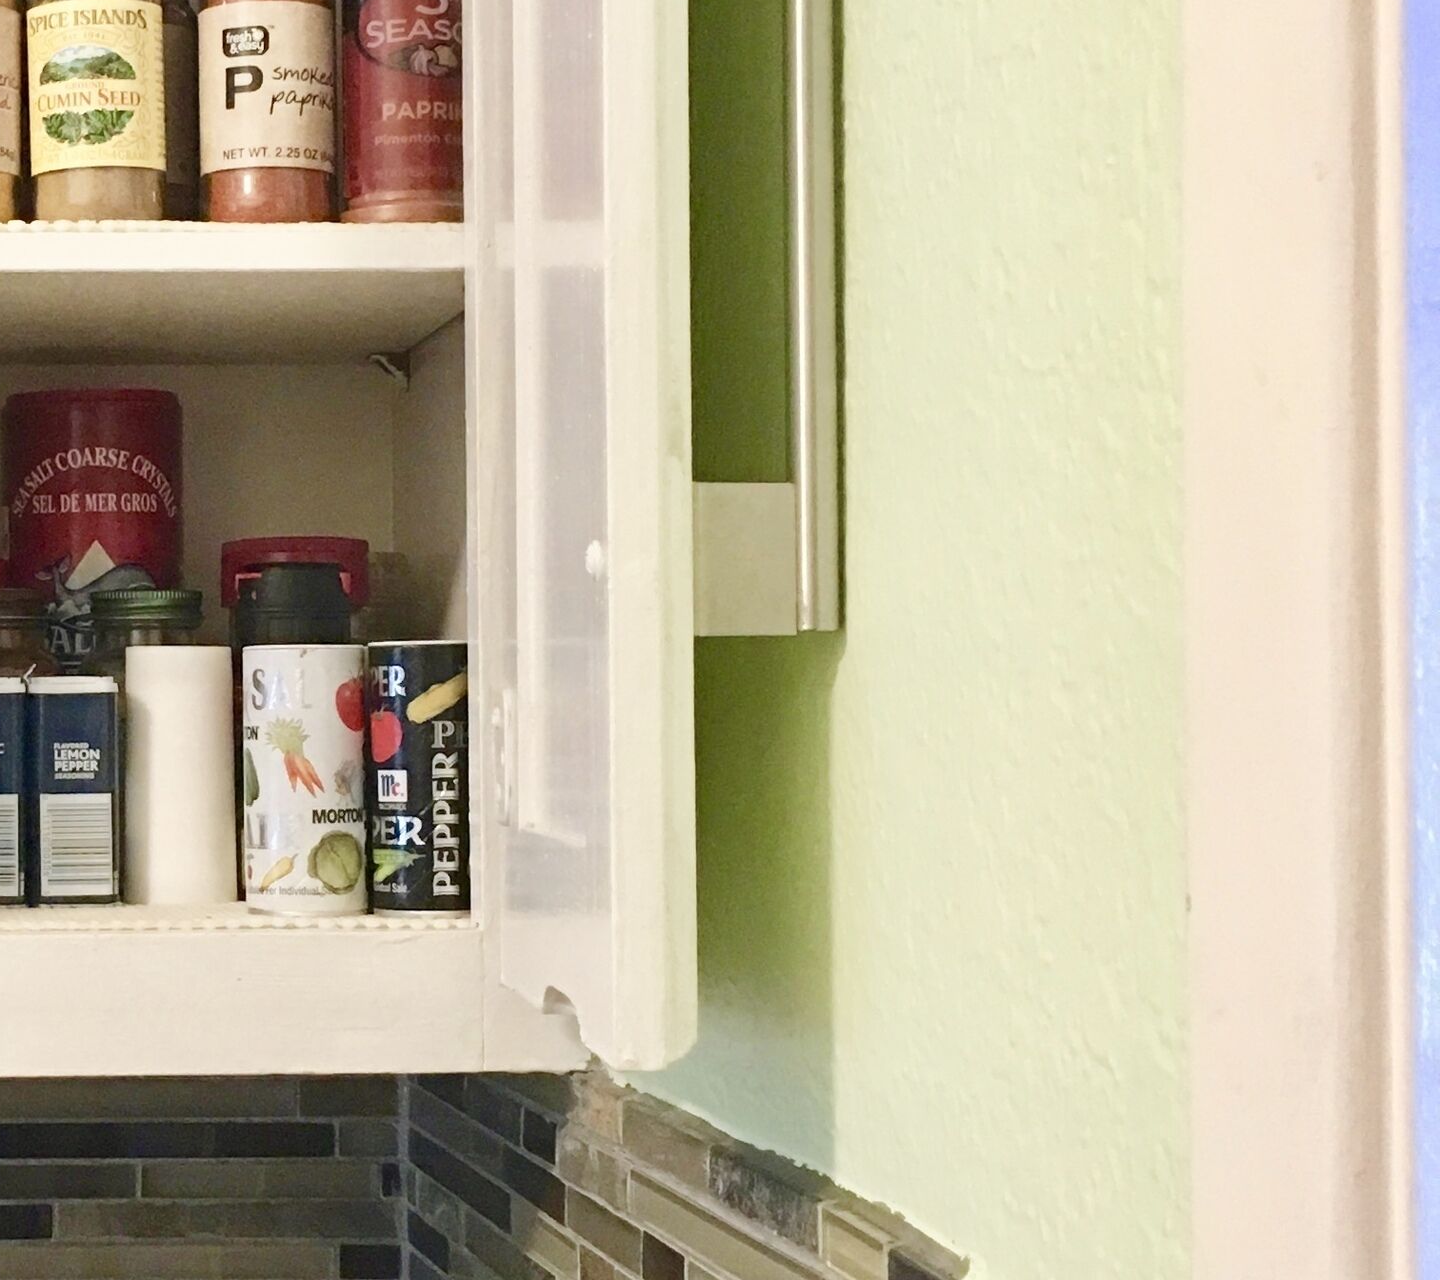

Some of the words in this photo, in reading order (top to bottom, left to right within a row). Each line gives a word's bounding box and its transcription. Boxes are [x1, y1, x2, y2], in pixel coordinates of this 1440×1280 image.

[29, 10, 68, 37] SPICE
[73, 9, 148, 29] ISLANDS
[226, 30, 252, 44] fresh
[230, 43, 239, 54] &
[238, 41, 264, 53] easy
[225, 65, 264, 110] P
[37, 91, 92, 112] CUMIN
[98, 88, 141, 107] SEED
[223, 148, 244, 160] NET
[275, 148, 301, 158] 2.25
[303, 149, 319, 160] OZ
[13, 488, 30, 517] SEA
[24, 458, 55, 493] SALT
[55, 447, 130, 471] COARSE
[132, 455, 177, 518] CRYSTALS
[32, 494, 55, 514] SEL
[61, 494, 80, 513] DE
[85, 493, 117, 513] MER
[121, 492, 158, 513] GROS
[54, 749, 101, 760] LEMON
[54, 761, 99, 772] PEPPER
[432, 751, 460, 896] PEPPER
